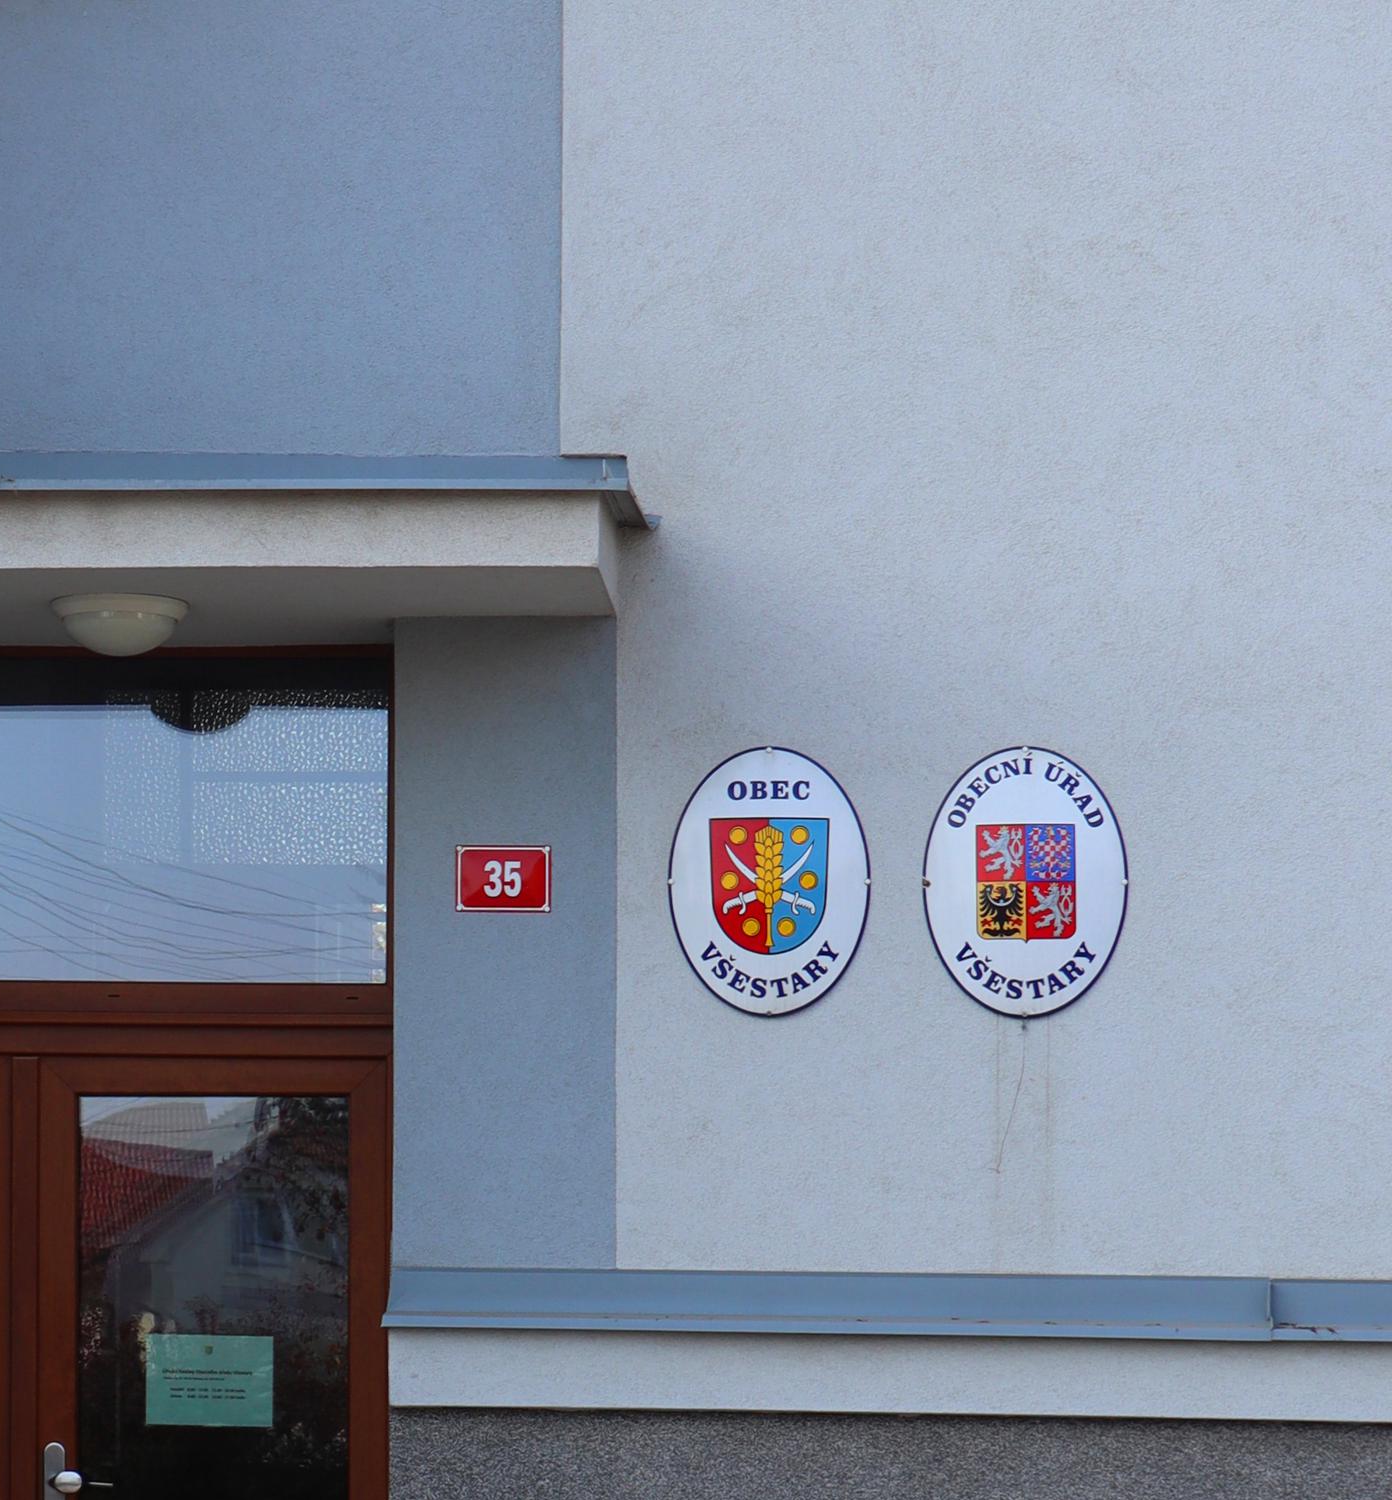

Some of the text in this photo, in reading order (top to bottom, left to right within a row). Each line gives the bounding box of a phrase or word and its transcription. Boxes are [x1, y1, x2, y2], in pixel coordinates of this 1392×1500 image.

[727, 780, 811, 801] OBEC
[948, 752, 1104, 828] OBECNÍ ÚŘAD
[483, 860, 522, 898] 35
[700, 940, 840, 999] VŠESTARY
[955, 942, 1097, 1000] VŠESTARY
